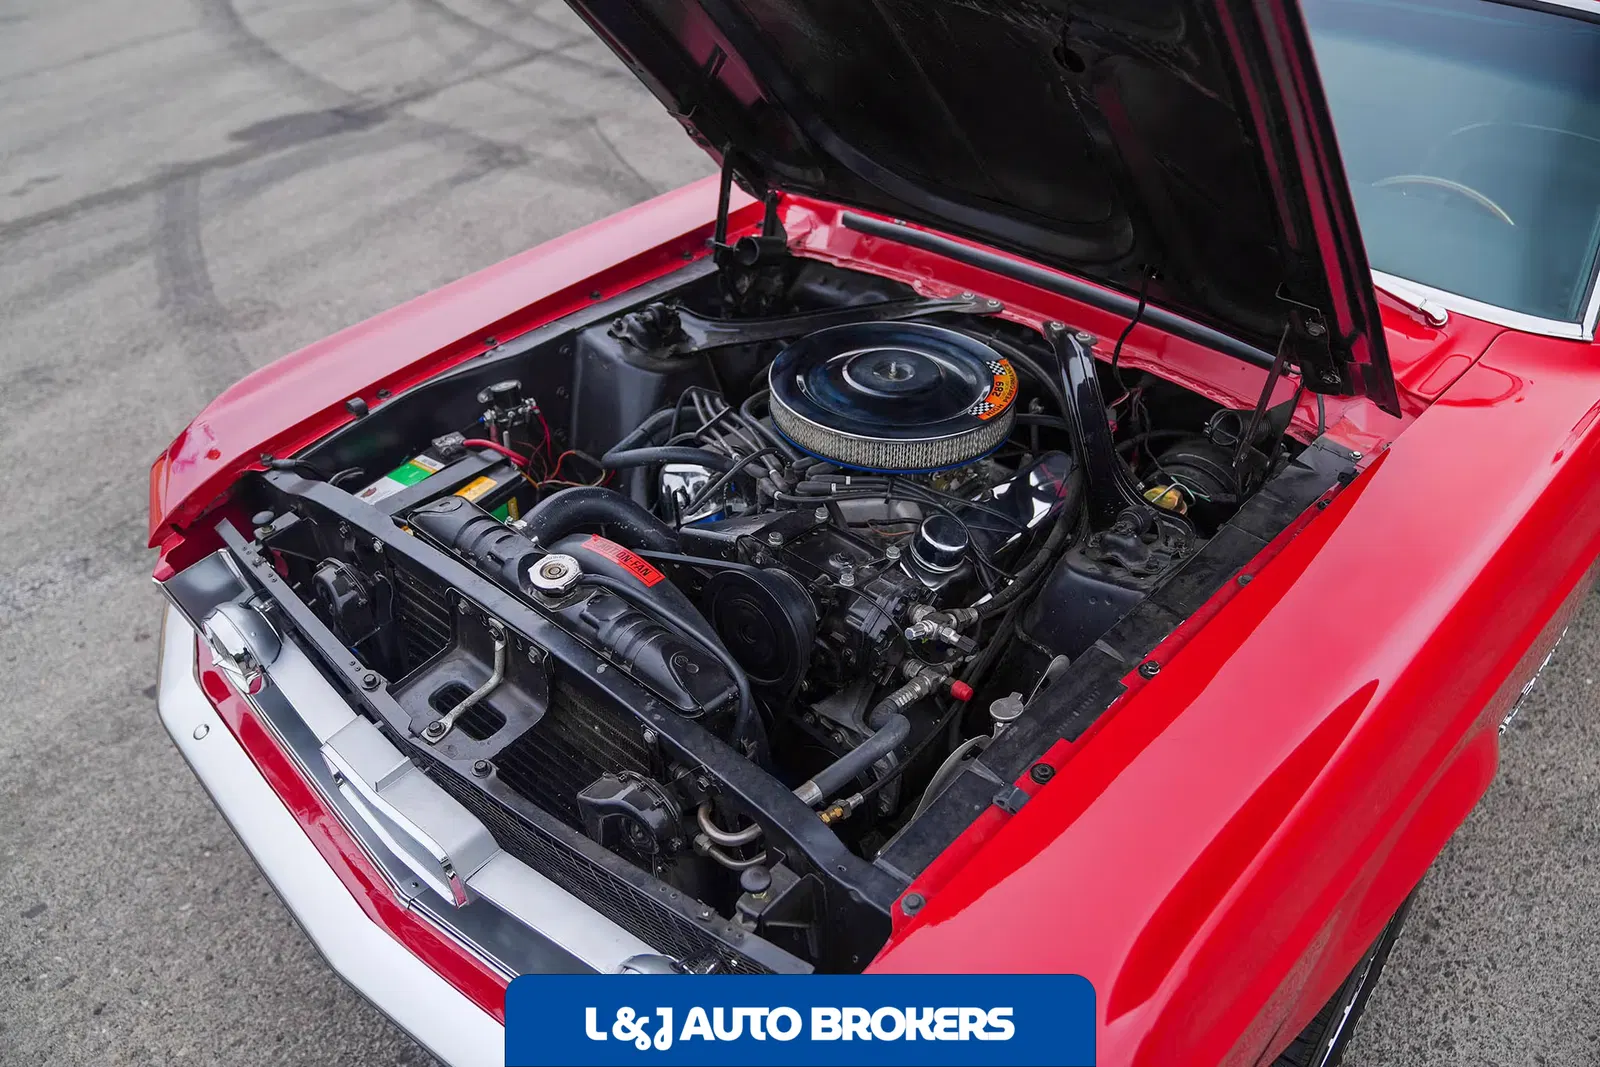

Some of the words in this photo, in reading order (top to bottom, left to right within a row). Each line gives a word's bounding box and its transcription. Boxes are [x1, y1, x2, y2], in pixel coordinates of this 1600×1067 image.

[986, 404, 1004, 416] HIGH
[1003, 363, 1016, 403] PERFORMANCE
[992, 381, 1004, 397] 289
